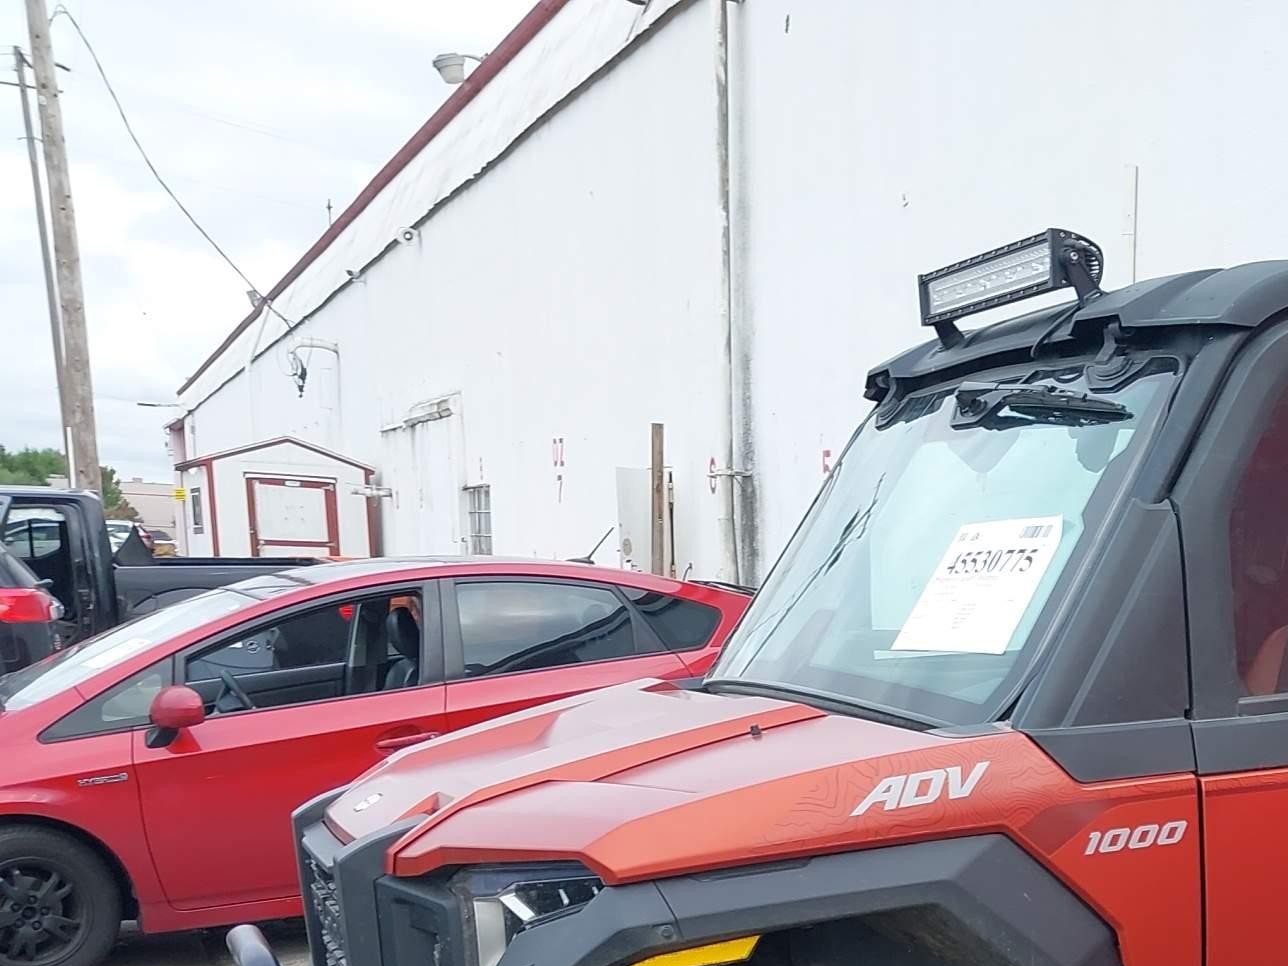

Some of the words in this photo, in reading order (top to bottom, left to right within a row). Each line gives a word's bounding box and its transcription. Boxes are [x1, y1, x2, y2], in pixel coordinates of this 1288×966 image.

[947, 548, 1039, 574] 45530775
[850, 761, 990, 817] ADV
[1085, 821, 1188, 855] 1000
